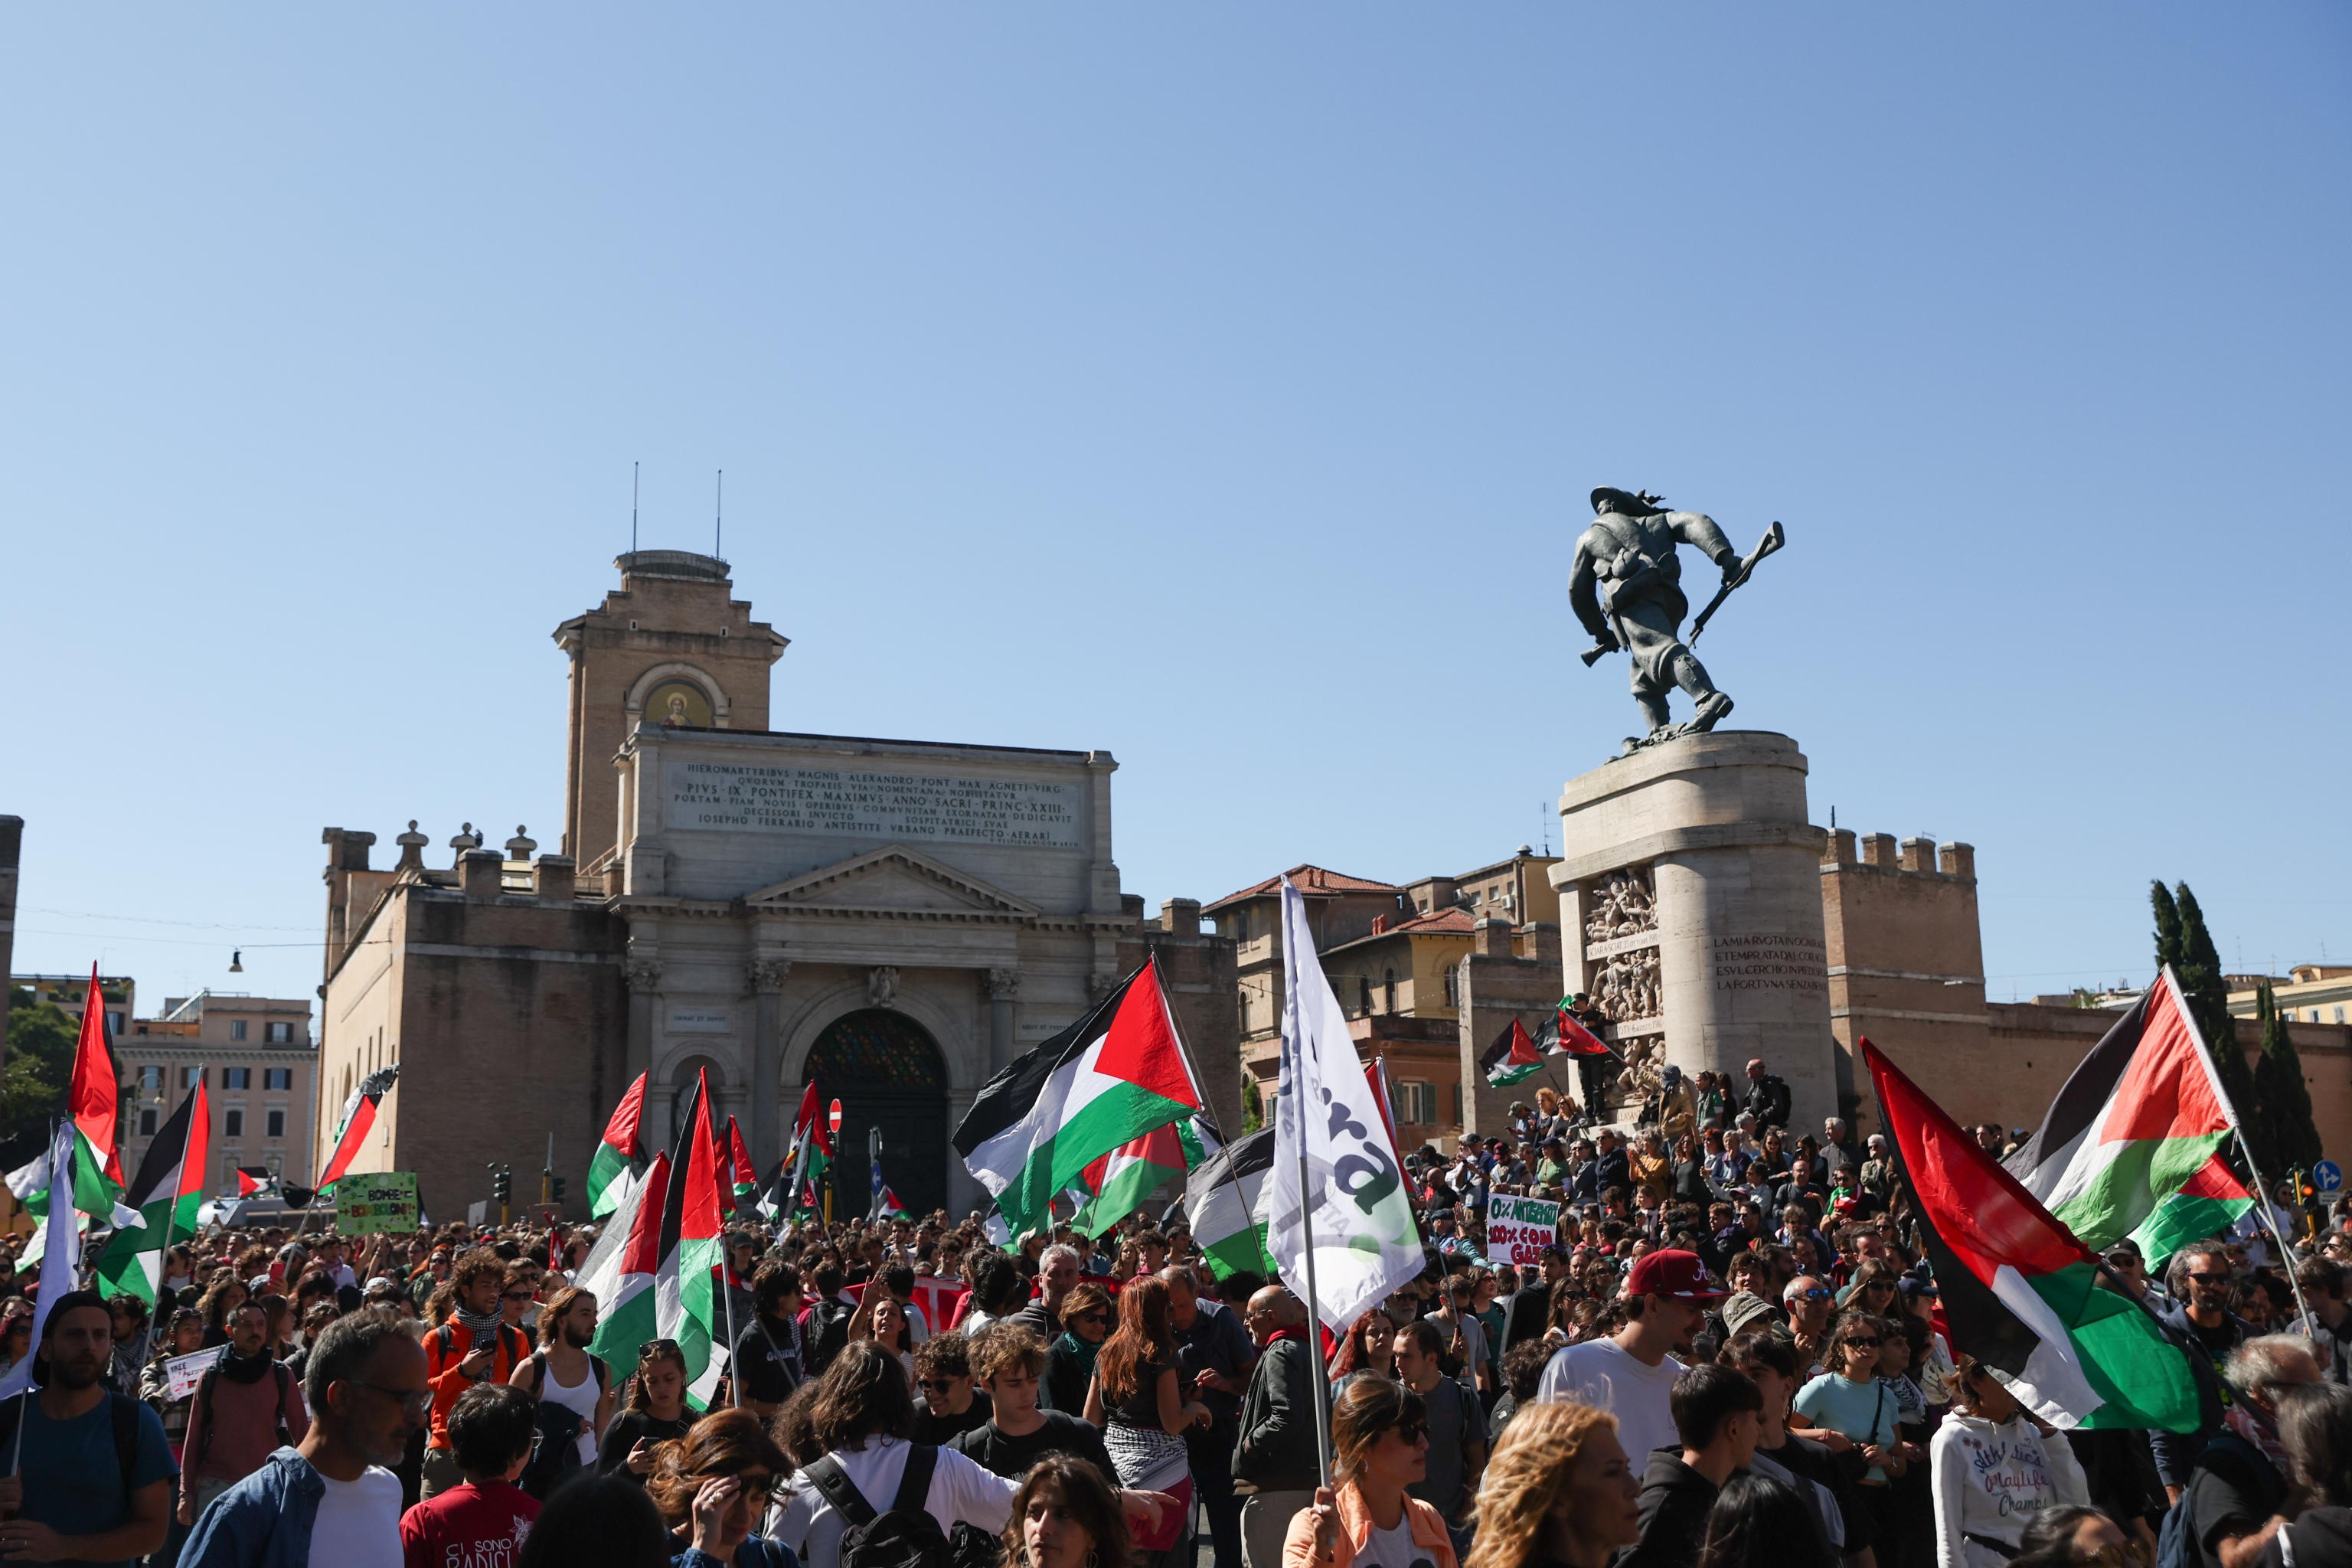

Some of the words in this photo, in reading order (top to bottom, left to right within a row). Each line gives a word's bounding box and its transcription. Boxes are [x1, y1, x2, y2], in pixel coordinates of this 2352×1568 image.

[797, 771, 839, 781] MAGNIS
[849, 774, 913, 785] ALEXANDRO
[922, 778, 950, 787] PONT
[959, 780, 981, 789] MAX
[687, 783, 717, 794] PIVS
[728, 786, 741, 795] IX
[751, 787, 814, 799] PONTIFEX
[824, 791, 883, 803] MAXIMVS
[892, 796, 926, 806] ANNO
[936, 798, 971, 808] SACRI
[982, 800, 1023, 811] PRINC
[675, 794, 720, 803] PORTAM
[730, 797, 754, 805] PIAM
[764, 799, 796, 808] NOVIS
[946, 809, 1007, 819] EXORNATAM
[1013, 813, 1072, 823] DEDICAVIT
[743, 808, 800, 818] DECESSORI
[809, 811, 854, 820] INVICTO
[698, 815, 749, 825] IOSEPHO
[759, 818, 815, 828] FERRARIO
[825, 822, 880, 831] ANTISTITE
[890, 825, 936, 835] VRBANO
[944, 827, 1004, 838] PRAEFECTO
[1511, 1243, 1542, 1265] GAZ
[475, 1538, 512, 1553] SONO
